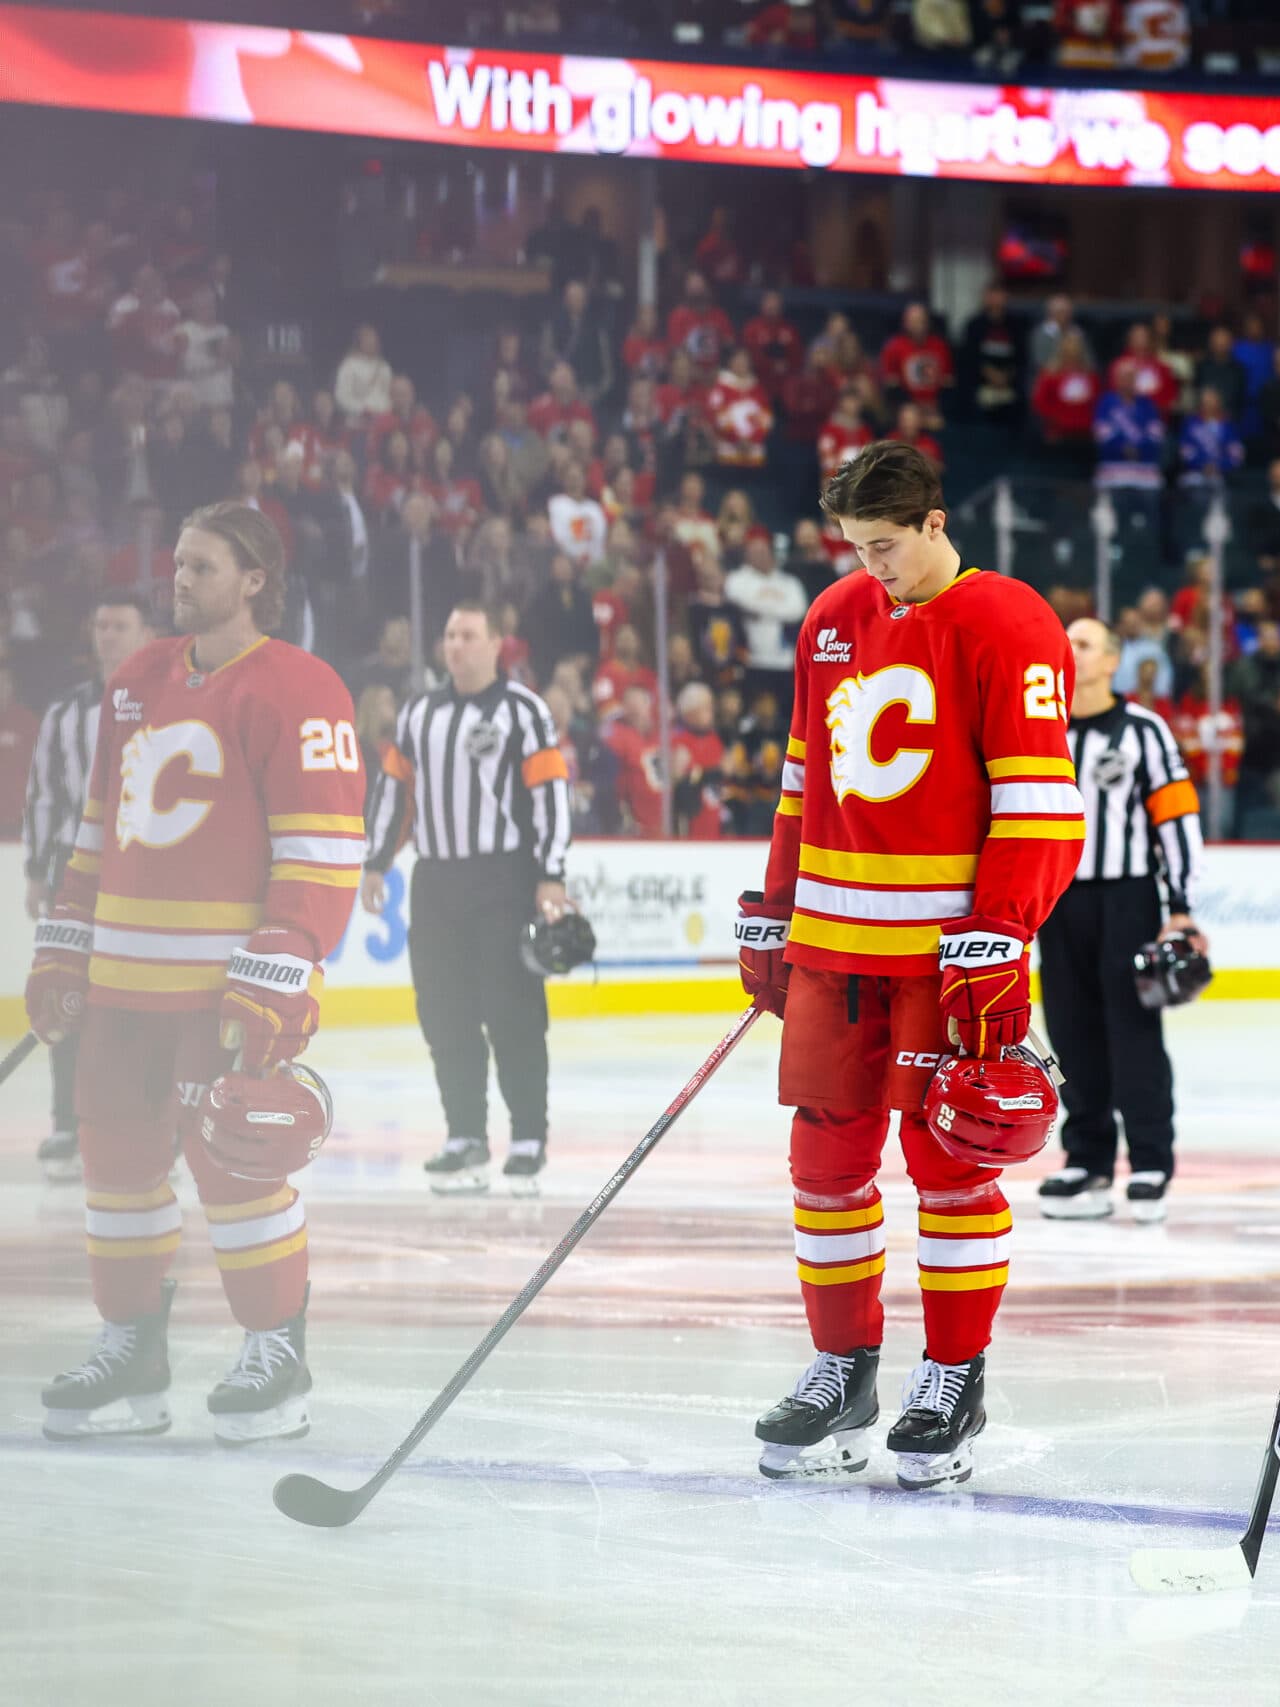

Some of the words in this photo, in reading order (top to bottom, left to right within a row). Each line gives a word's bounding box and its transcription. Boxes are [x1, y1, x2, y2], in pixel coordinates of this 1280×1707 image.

[428, 60, 573, 135] With
[590, 77, 841, 167] glowing
[856, 92, 1055, 166] hearts
[1068, 119, 1172, 170] we
[813, 652, 851, 663] alberta
[826, 640, 852, 653] play
[300, 718, 359, 773] 20
[936, 1103, 956, 1132] 29
